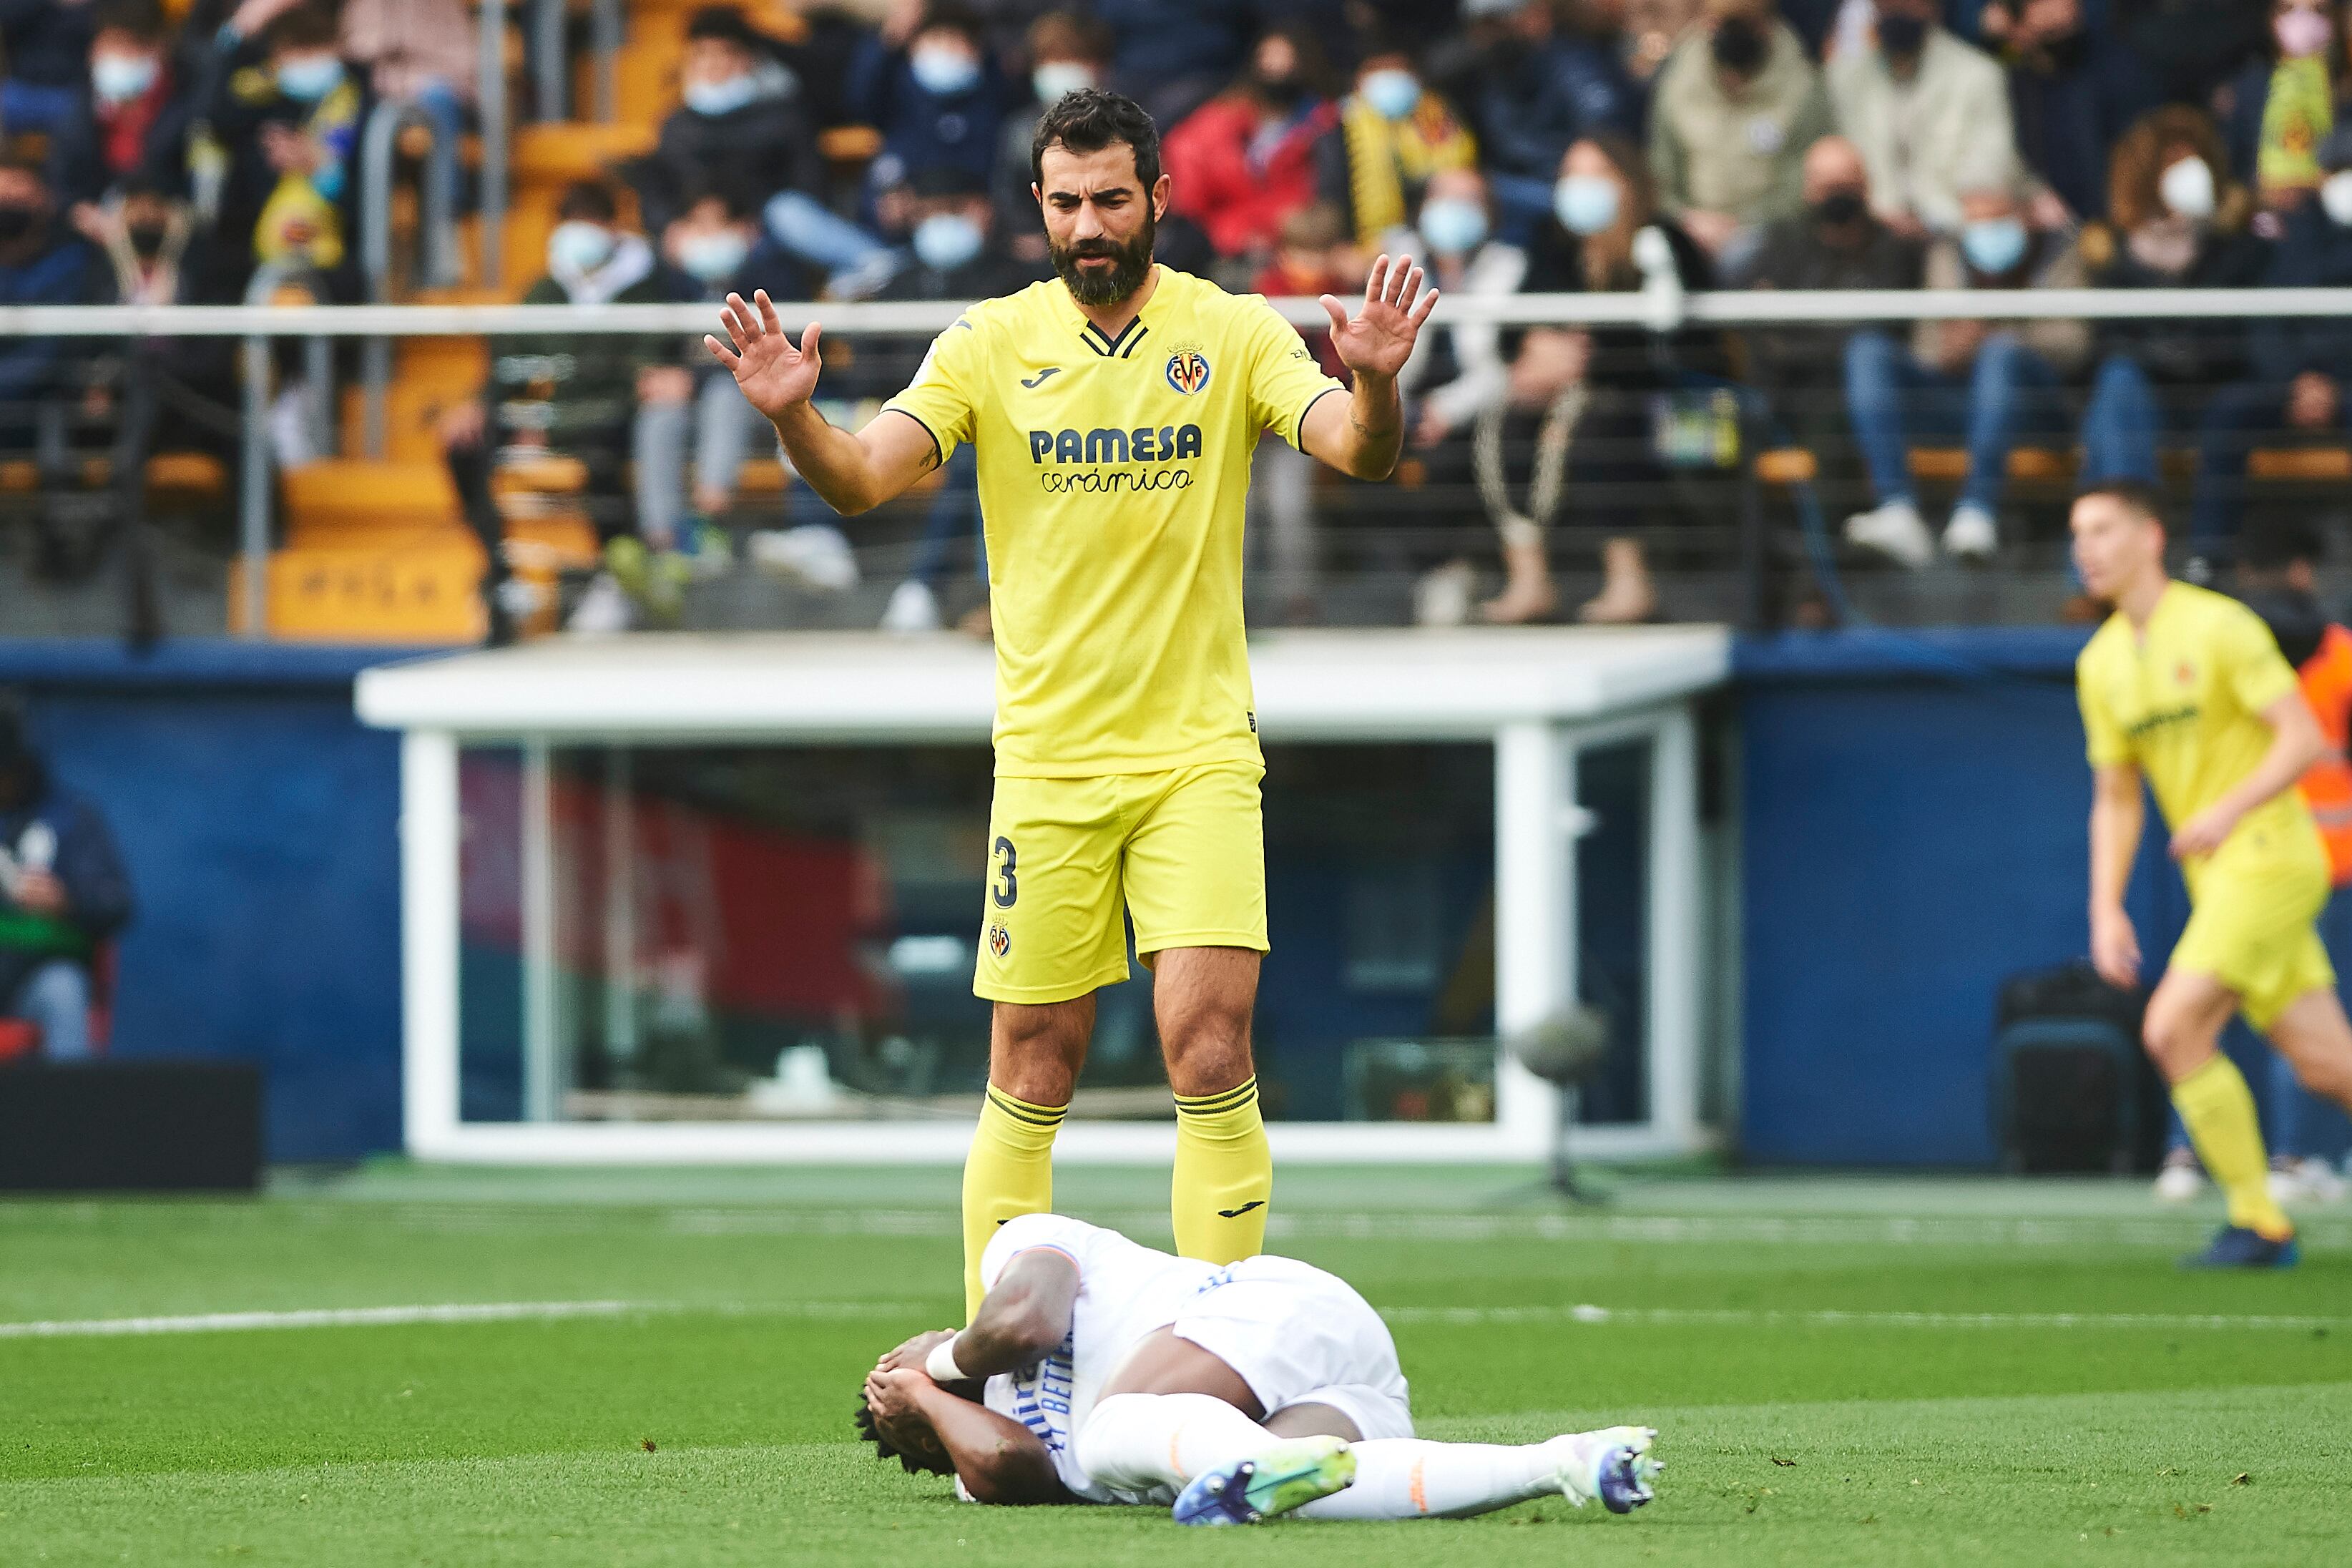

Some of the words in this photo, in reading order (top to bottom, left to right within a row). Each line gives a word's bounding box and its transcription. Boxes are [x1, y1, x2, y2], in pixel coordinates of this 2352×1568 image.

[1030, 423, 1202, 464] PAMESA
[1042, 468, 1194, 493] cerámica
[992, 836, 1018, 909] 3
